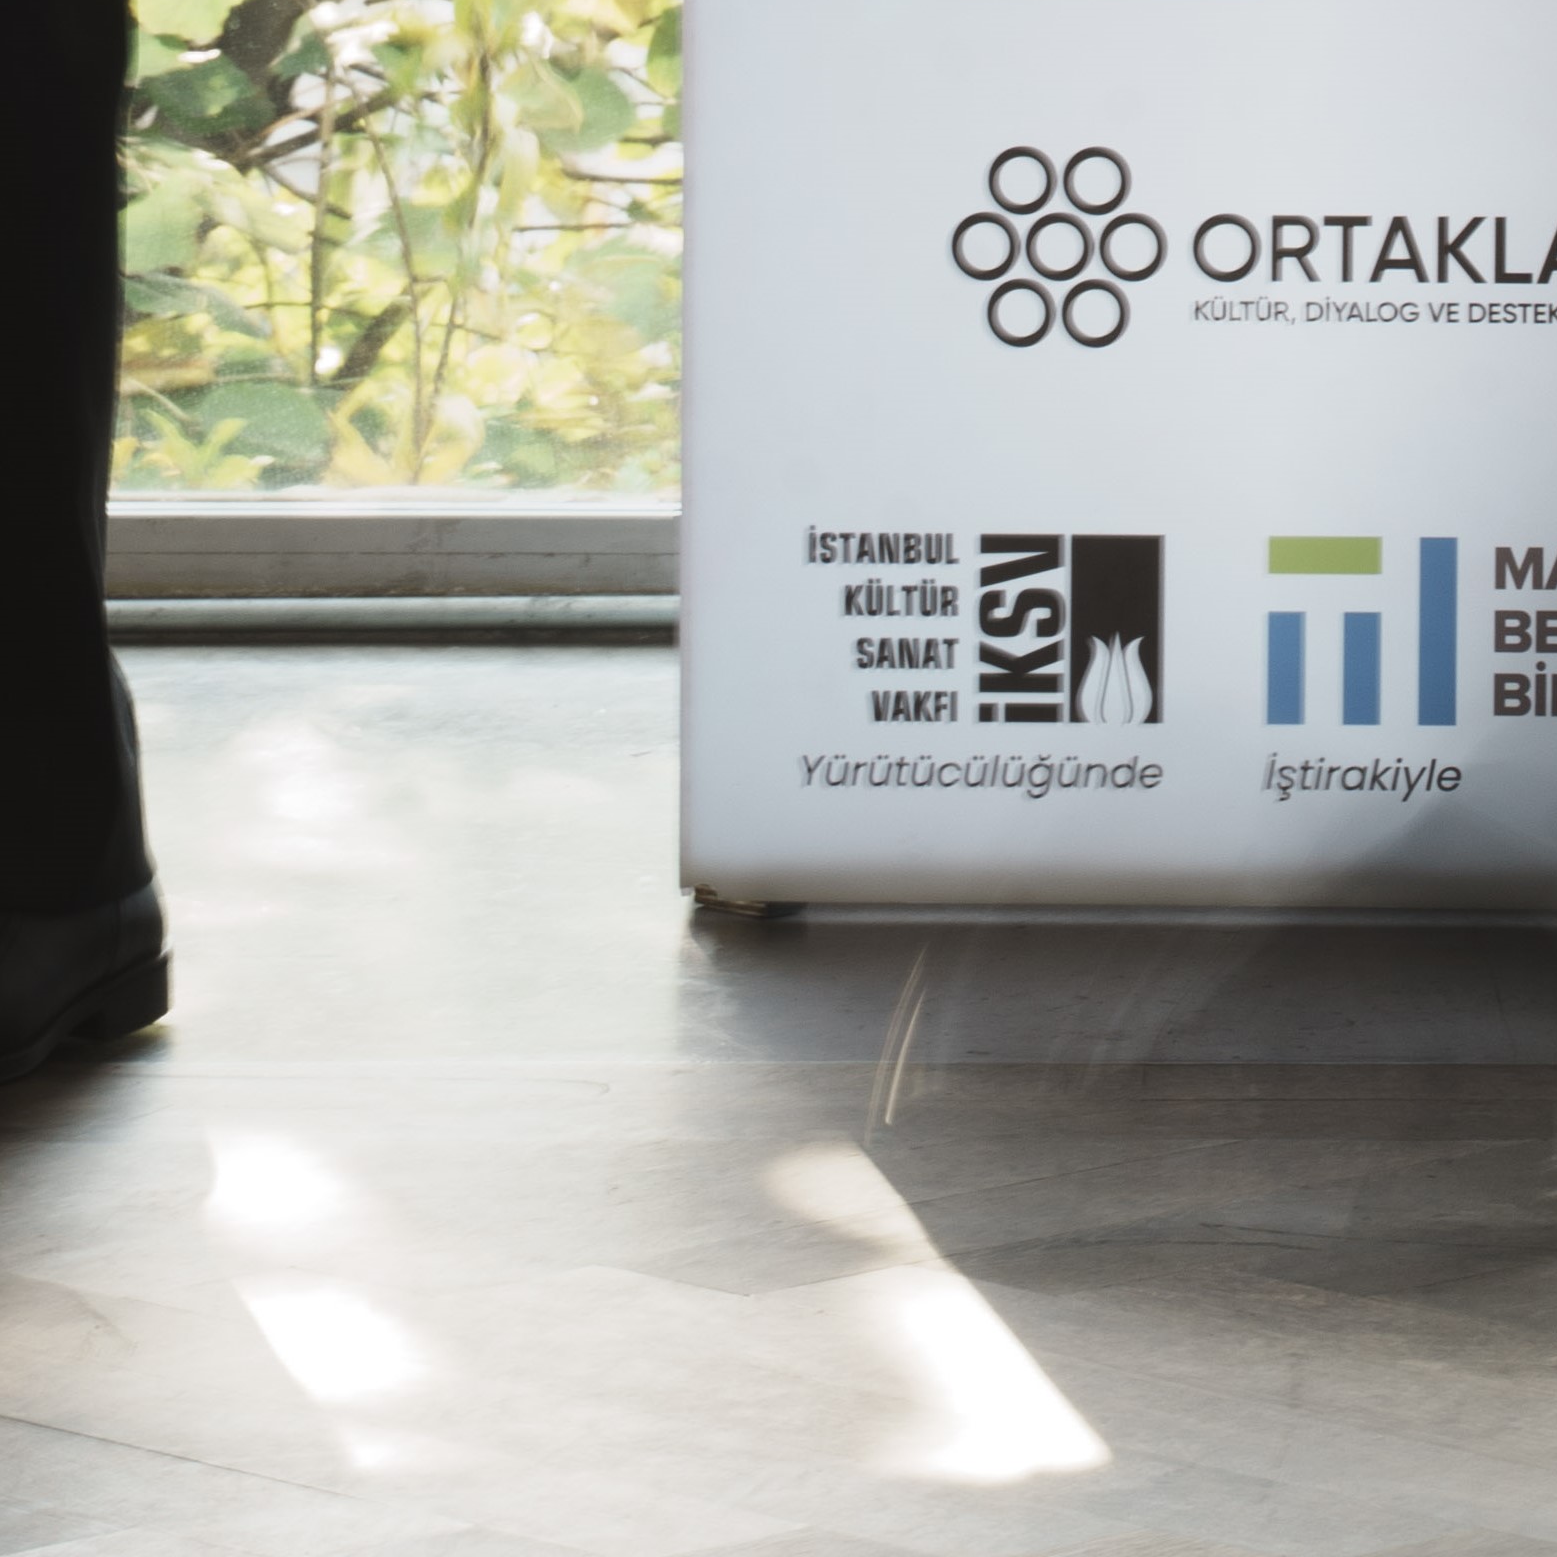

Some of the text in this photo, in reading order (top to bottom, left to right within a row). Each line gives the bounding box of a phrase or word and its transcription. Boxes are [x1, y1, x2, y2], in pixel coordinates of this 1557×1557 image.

[1306, 297, 1420, 323] DİYALOG
[1428, 303, 1459, 323] VE
[806, 525, 958, 564] İSTANBUL
[844, 579, 958, 617] KÜLTÜR
[856, 638, 958, 669] SANAT
[872, 691, 957, 722] VAKFI
[801, 755, 1163, 799] Yürütücülüğünde
[1264, 752, 1463, 802] İştirakiyle
